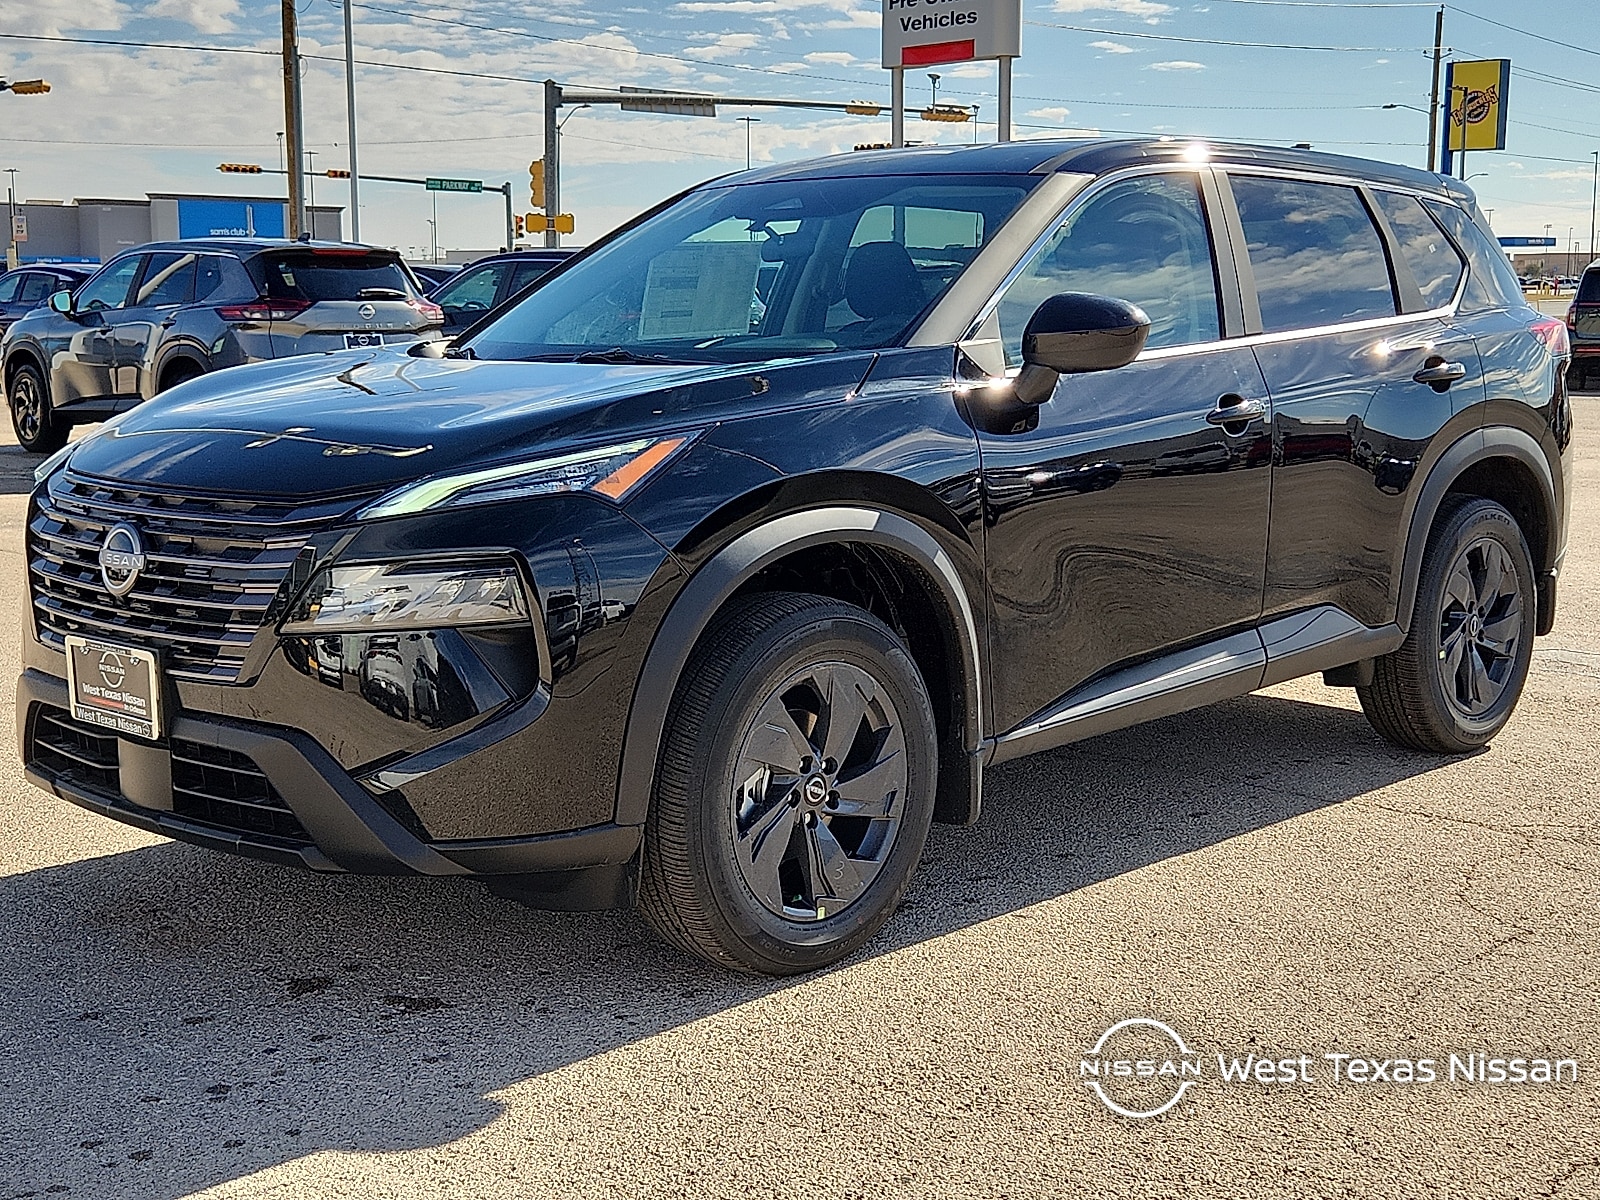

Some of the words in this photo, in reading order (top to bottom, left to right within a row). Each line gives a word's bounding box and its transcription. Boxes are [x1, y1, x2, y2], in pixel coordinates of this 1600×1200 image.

[899, 10, 978, 32] Vehicles
[442, 180, 470, 190] PARKWAY
[99, 664, 125, 675] NISSAN
[82, 683, 100, 696] West
[100, 686, 122, 701] Texas
[122, 692, 146, 707] Nissan
[77, 708, 95, 721] West
[96, 712, 116, 726] Texas
[118, 718, 142, 733] Nissan
